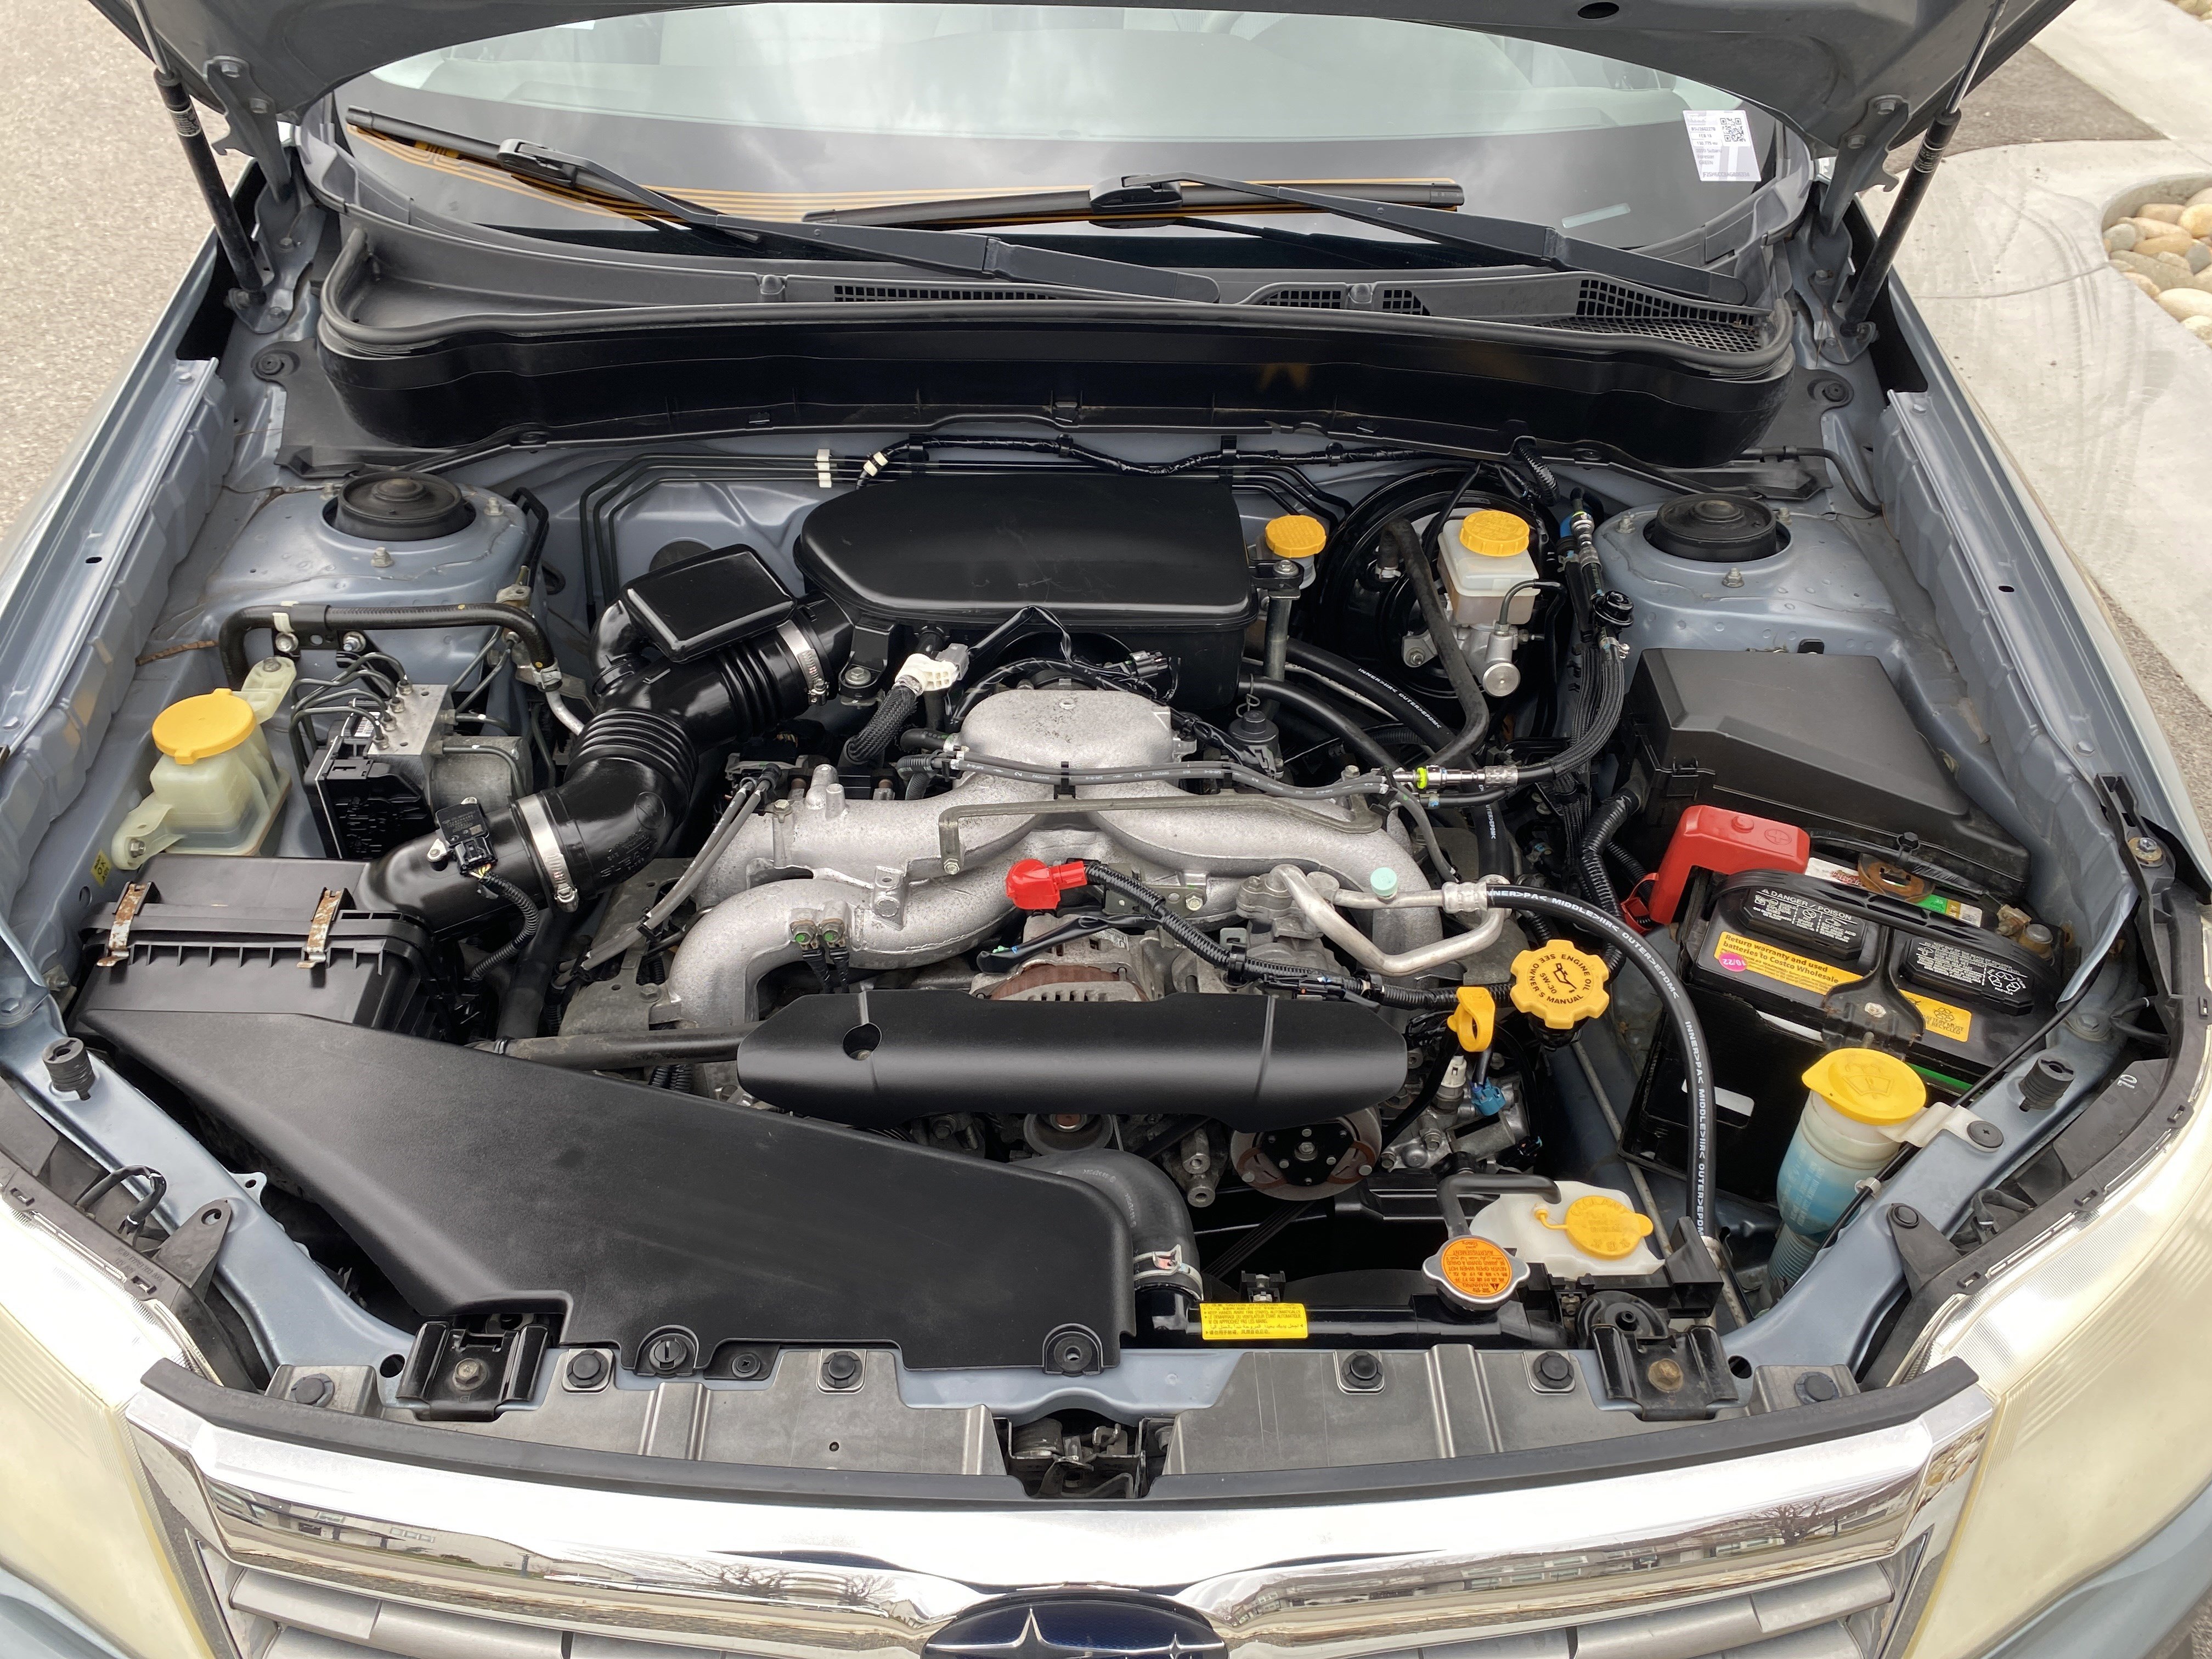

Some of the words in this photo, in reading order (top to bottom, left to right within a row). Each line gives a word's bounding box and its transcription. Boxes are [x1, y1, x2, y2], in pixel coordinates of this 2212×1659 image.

[1771, 890, 1808, 907] DANGER
[1818, 906, 1852, 921] POISON
[1821, 922, 1844, 932] SULFURIC
[1539, 953, 1556, 963] SEE
[1723, 941, 1758, 957] batteries
[1759, 950, 1768, 960] to
[1770, 955, 1796, 969] Costco
[1797, 965, 1839, 984] Wholesale
[1725, 934, 1752, 947] Return
[1754, 944, 1790, 961] warranty
[1791, 957, 1807, 966] and
[1808, 962, 1828, 973] used
[1529, 963, 1545, 997] OWNER'S
[1561, 954, 1590, 977] ENGINE
[1583, 979, 1591, 991] OIL
[1539, 973, 1557, 994] 5W-30
[1994, 988, 2013, 996] RECYCLE
[1547, 994, 1584, 1004] MANUAL
[1924, 1014, 1946, 1026] ATTERY
[1946, 1023, 1964, 1031] MUST
[1931, 1021, 1961, 1035] RECYCLED
